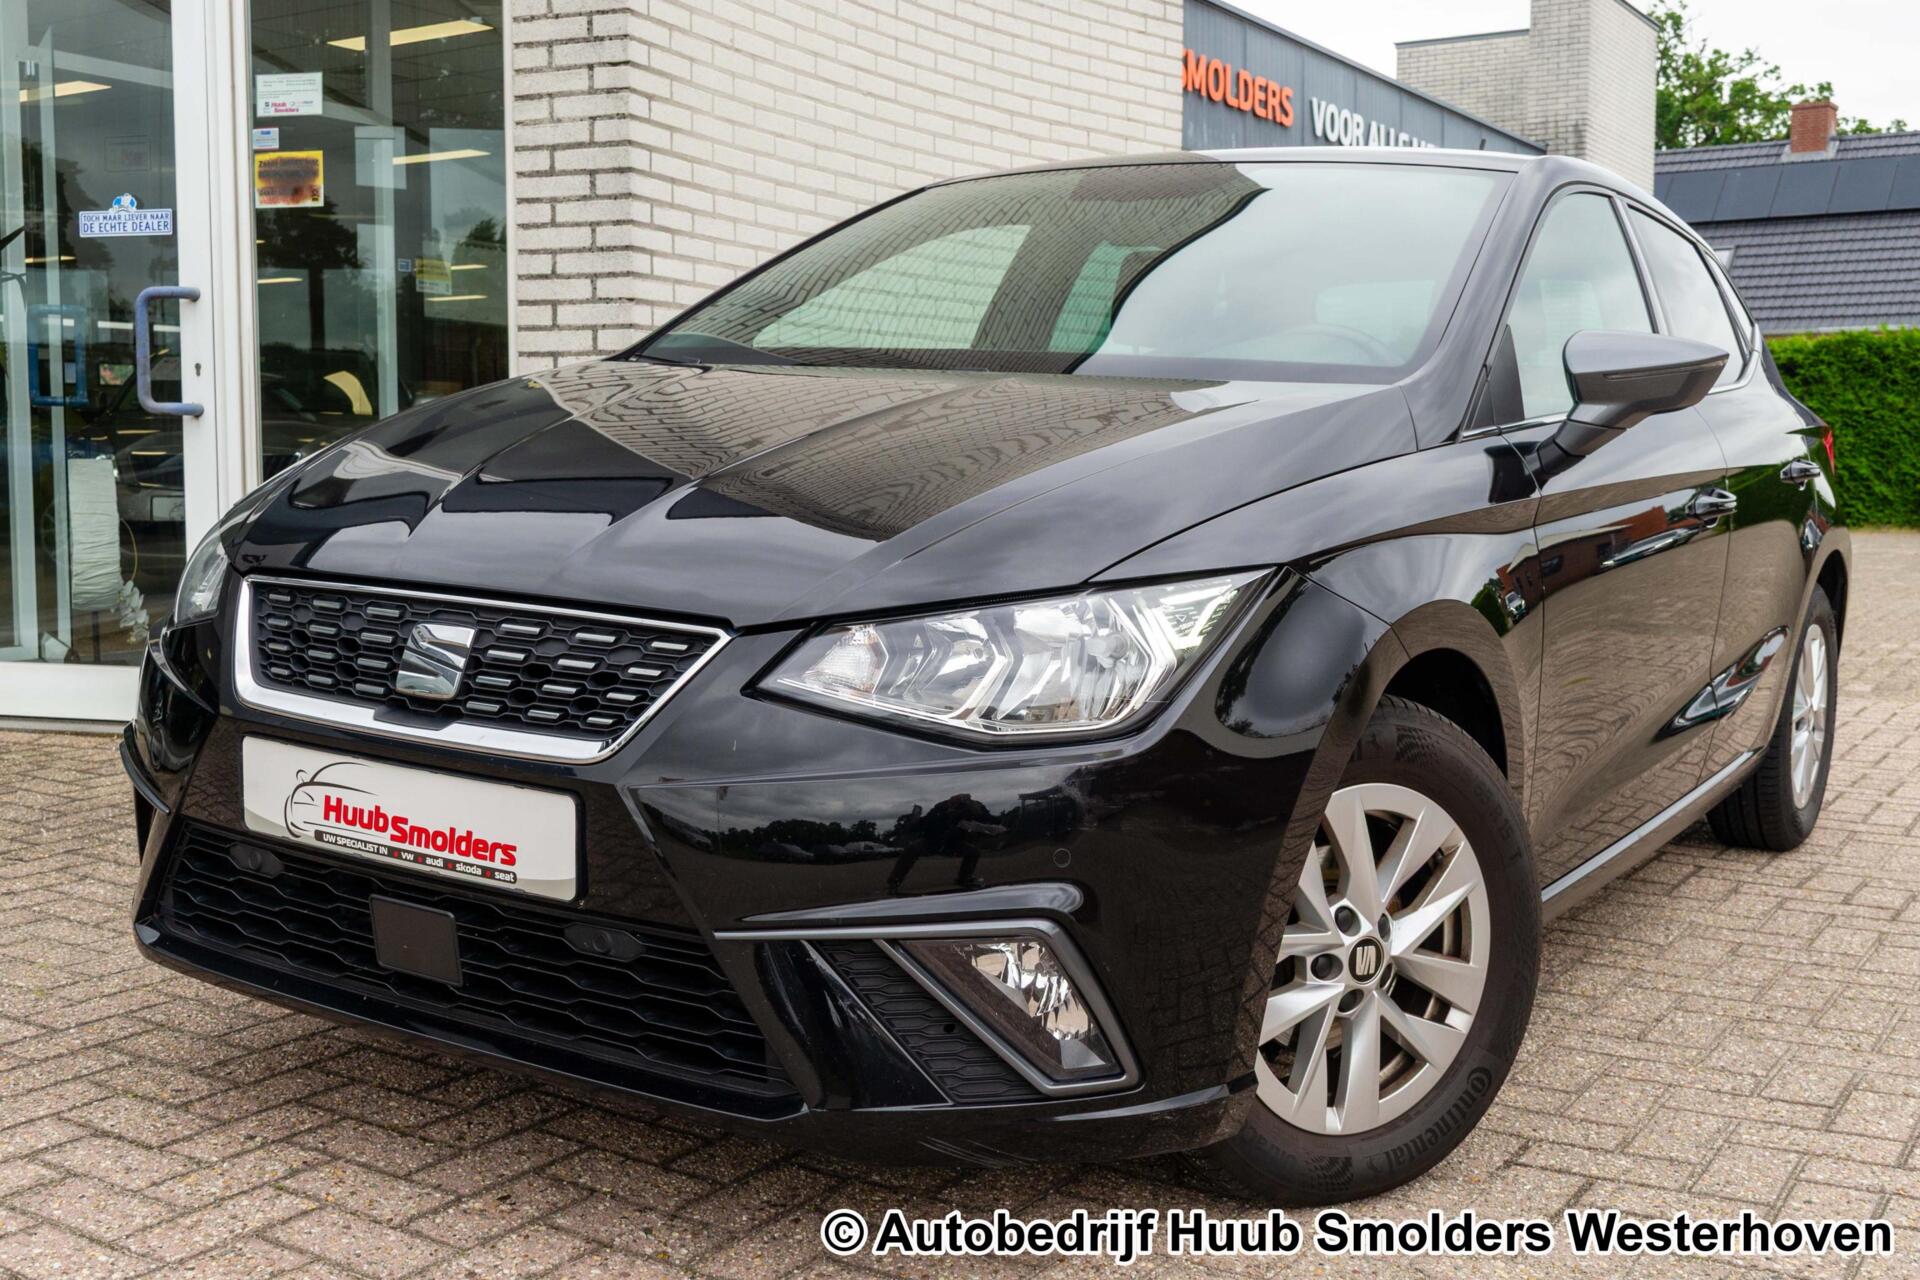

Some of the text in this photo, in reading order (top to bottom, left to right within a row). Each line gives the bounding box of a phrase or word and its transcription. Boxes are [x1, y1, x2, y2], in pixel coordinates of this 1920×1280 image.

[1311, 96, 1364, 146] VOOR
[83, 221, 169, 233] DE ECHTE DEALER
[124, 213, 147, 221] LIEVER
[323, 833, 336, 843] UW
[337, 837, 379, 853] SPECIALIST
[379, 846, 388, 855] IN
[425, 857, 444, 867] audi
[455, 863, 482, 876] skoda
[494, 870, 515, 882] seat
